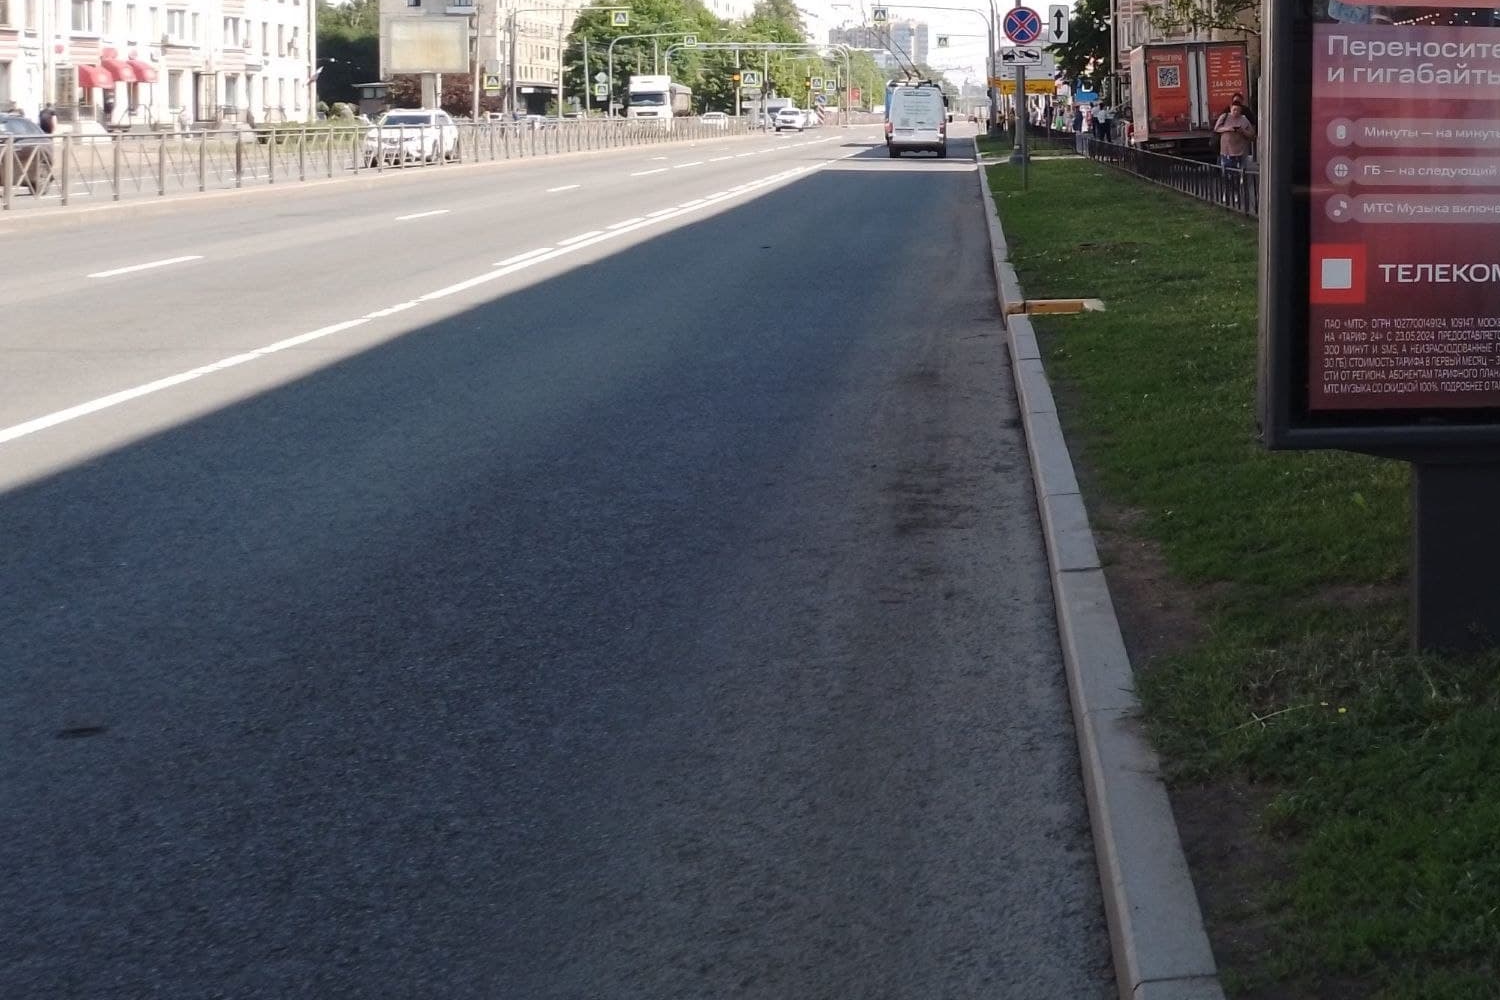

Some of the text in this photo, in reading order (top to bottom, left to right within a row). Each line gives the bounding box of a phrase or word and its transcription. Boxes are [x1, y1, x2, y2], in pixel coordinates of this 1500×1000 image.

[1328, 67, 1345, 83] и
[1364, 126, 1419, 140] Минуты
[1436, 129, 1453, 139] на
[1363, 165, 1380, 176] ГБ
[1398, 167, 1416, 177] на
[1417, 165, 1500, 179] следующий
[1363, 203, 1395, 214] МТС
[1396, 203, 1449, 216] Музыка
